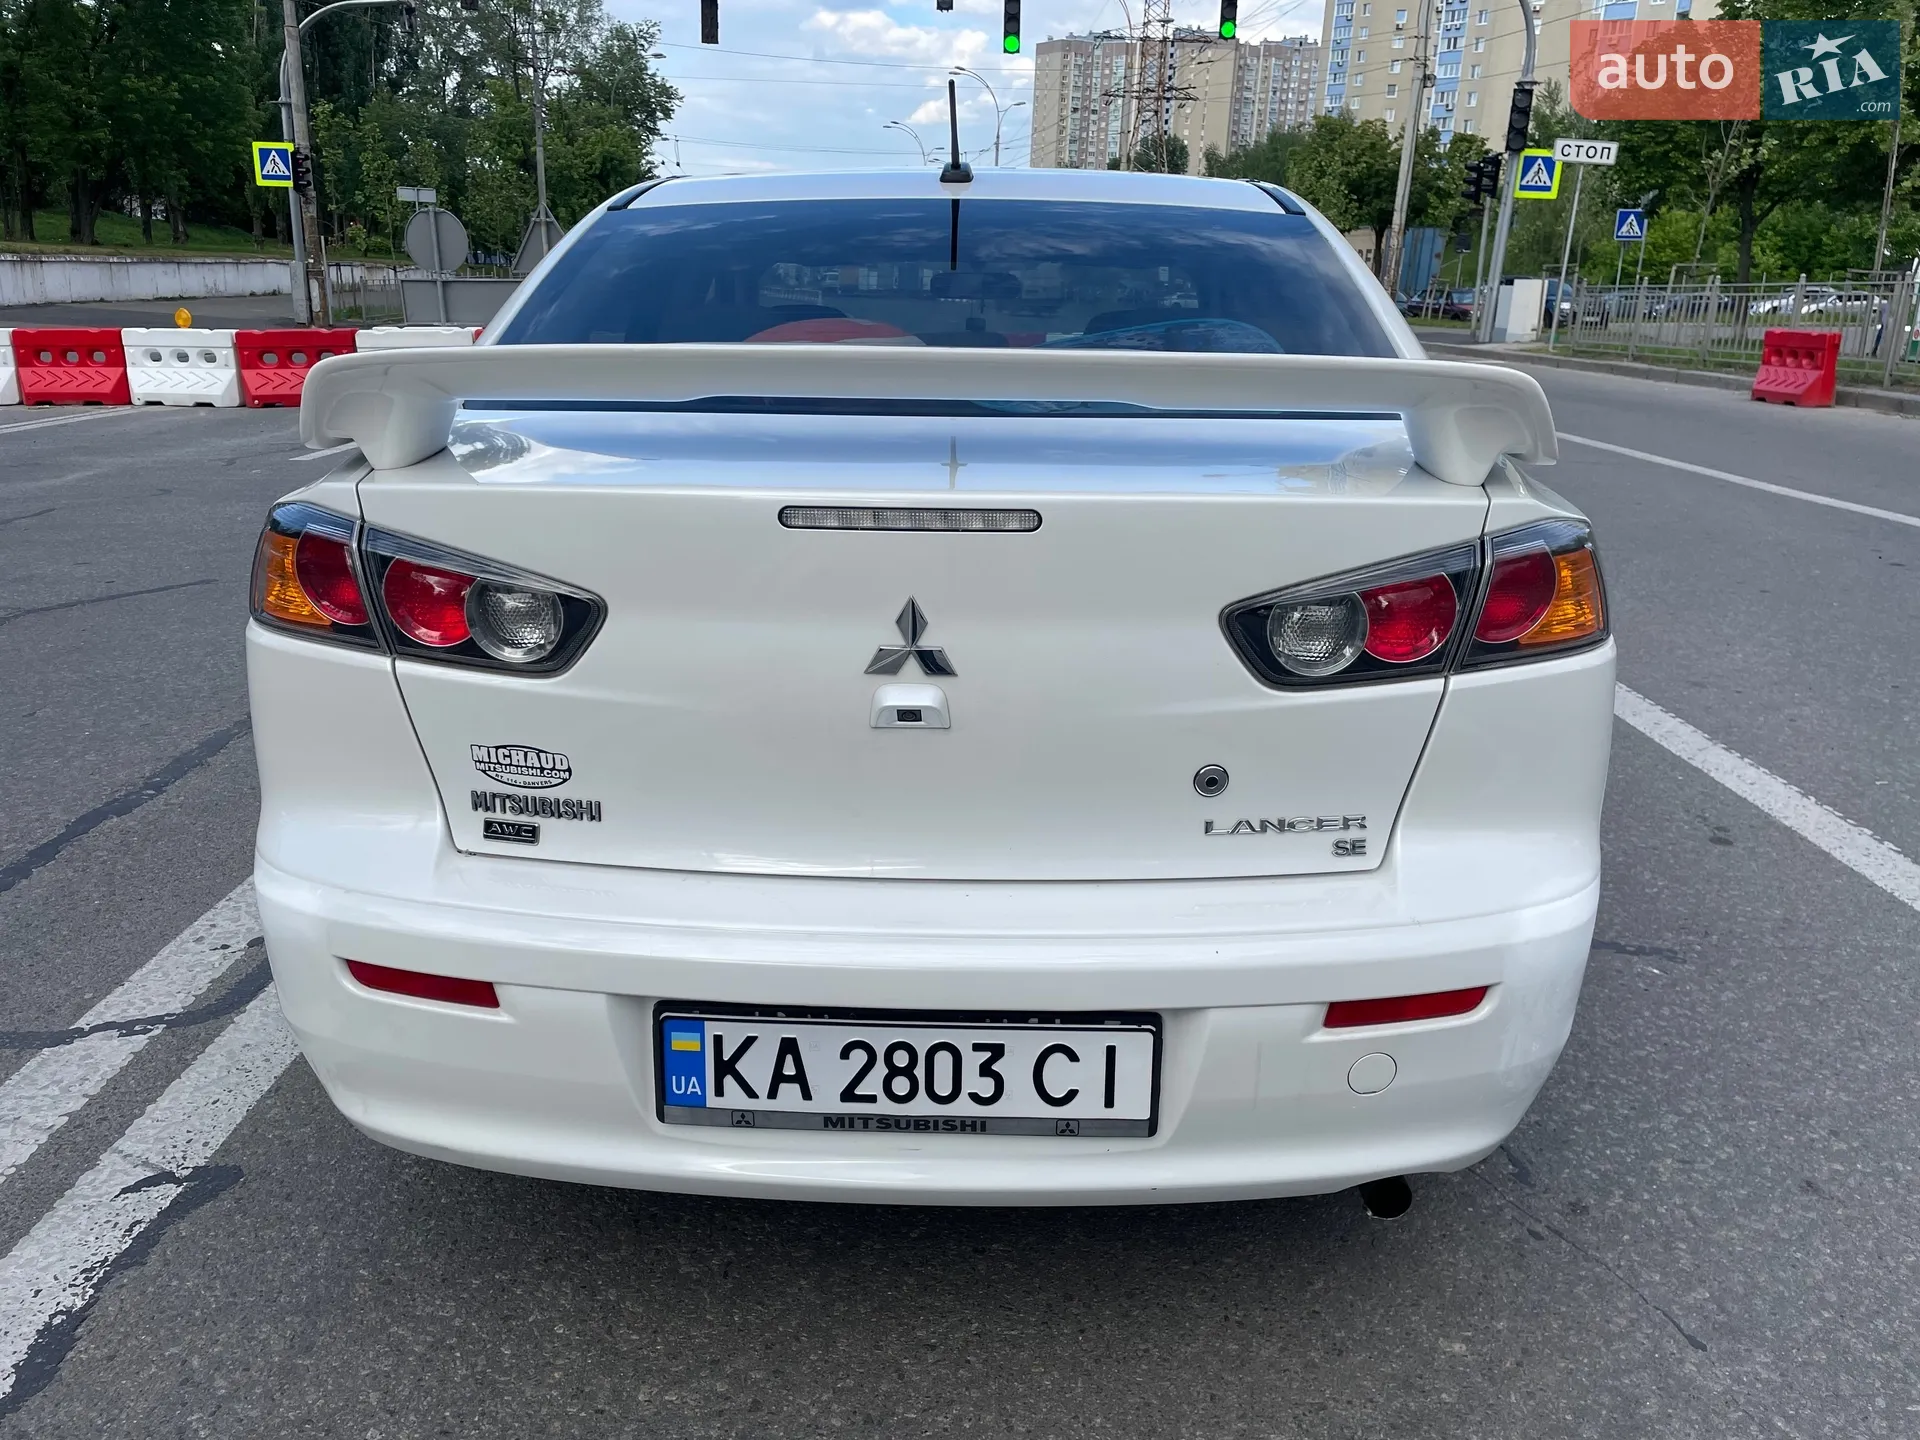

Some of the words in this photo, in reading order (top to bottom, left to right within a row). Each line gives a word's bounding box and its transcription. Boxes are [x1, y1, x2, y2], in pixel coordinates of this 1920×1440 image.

[1560, 144, 1612, 160] СТОП
[471, 745, 569, 770] MICHAUD
[475, 762, 570, 780] MITSUBISHI.COM
[470, 790, 602, 822] MITSUBISHI
[488, 822, 533, 837] AWC
[1204, 813, 1368, 835] LANCER
[1331, 837, 1367, 857] SE
[712, 1033, 813, 1101] KA
[838, 1039, 1006, 1107] 2803
[1032, 1043, 1118, 1109] CI
[671, 1075, 703, 1096] UA
[822, 1116, 988, 1132] MITSUBISHI
